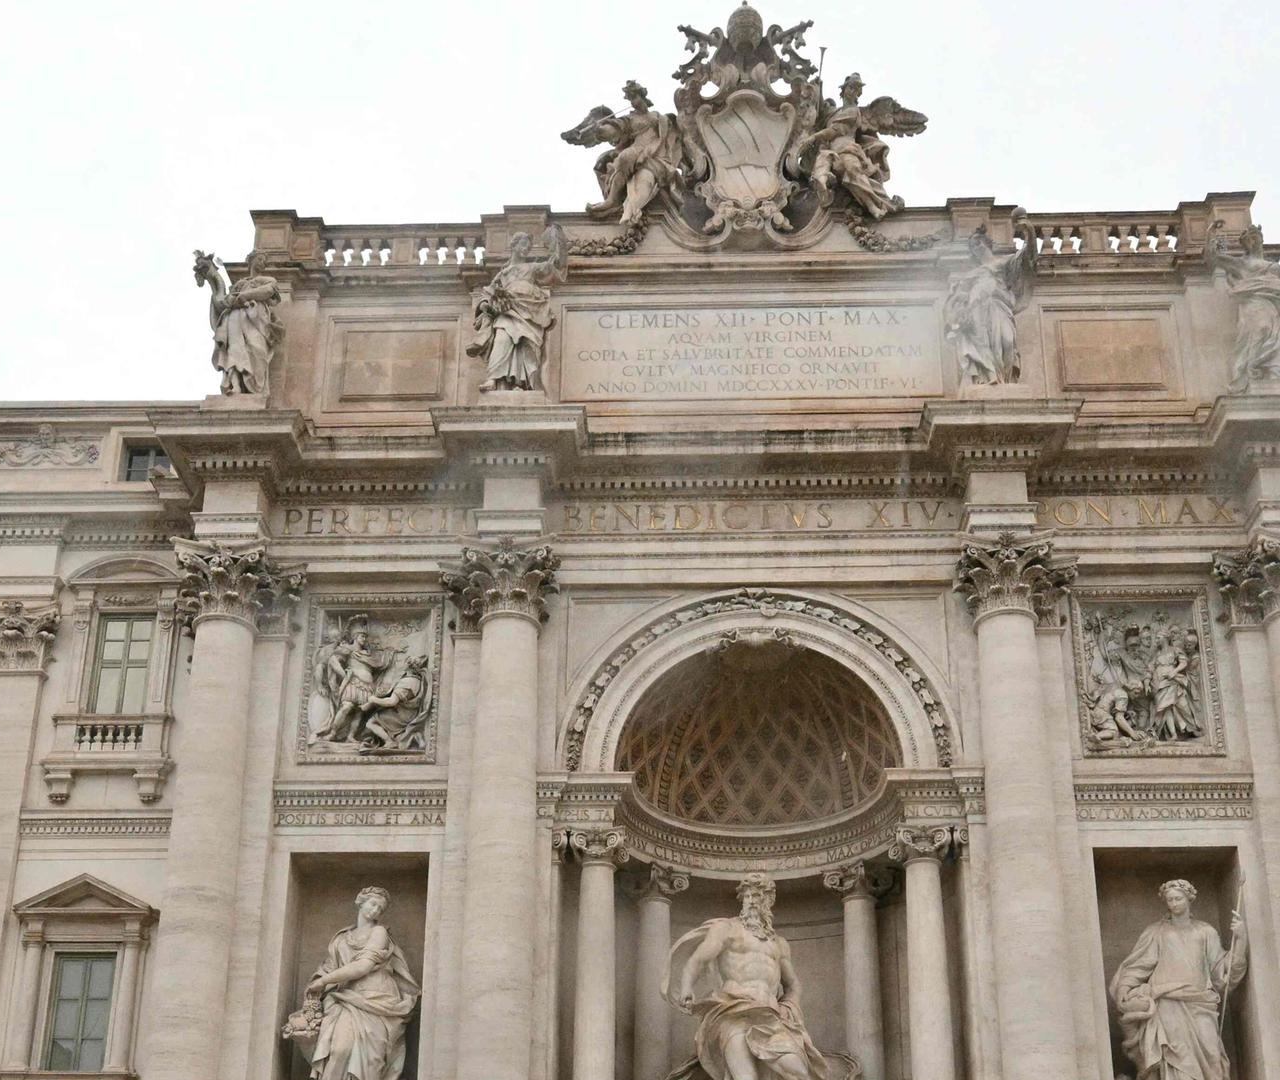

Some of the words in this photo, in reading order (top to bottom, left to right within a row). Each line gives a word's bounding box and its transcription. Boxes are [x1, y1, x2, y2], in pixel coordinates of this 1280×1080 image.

[598, 313, 701, 329] CLEMENS
[667, 332, 731, 347] AQVAM
[743, 330, 832, 344] VIRGINEM
[577, 350, 629, 362] COPIA
[636, 349, 656, 361] ET
[662, 346, 774, 361] SALVBRITATE
[783, 344, 922, 359] COMMENDATAM
[622, 364, 678, 377] CVLTV
[690, 362, 791, 377] MAGNIFICO
[799, 361, 880, 375] ORNAVIT
[584, 381, 636, 394] ANNO
[642, 379, 709, 393] DOMINI
[283, 507, 477, 535] PERFECIT
[562, 502, 833, 532] BENEDICTVS
[276, 813, 327, 825] POSITIS
[334, 813, 376, 825] SIGNIS
[384, 813, 401, 825] ET
